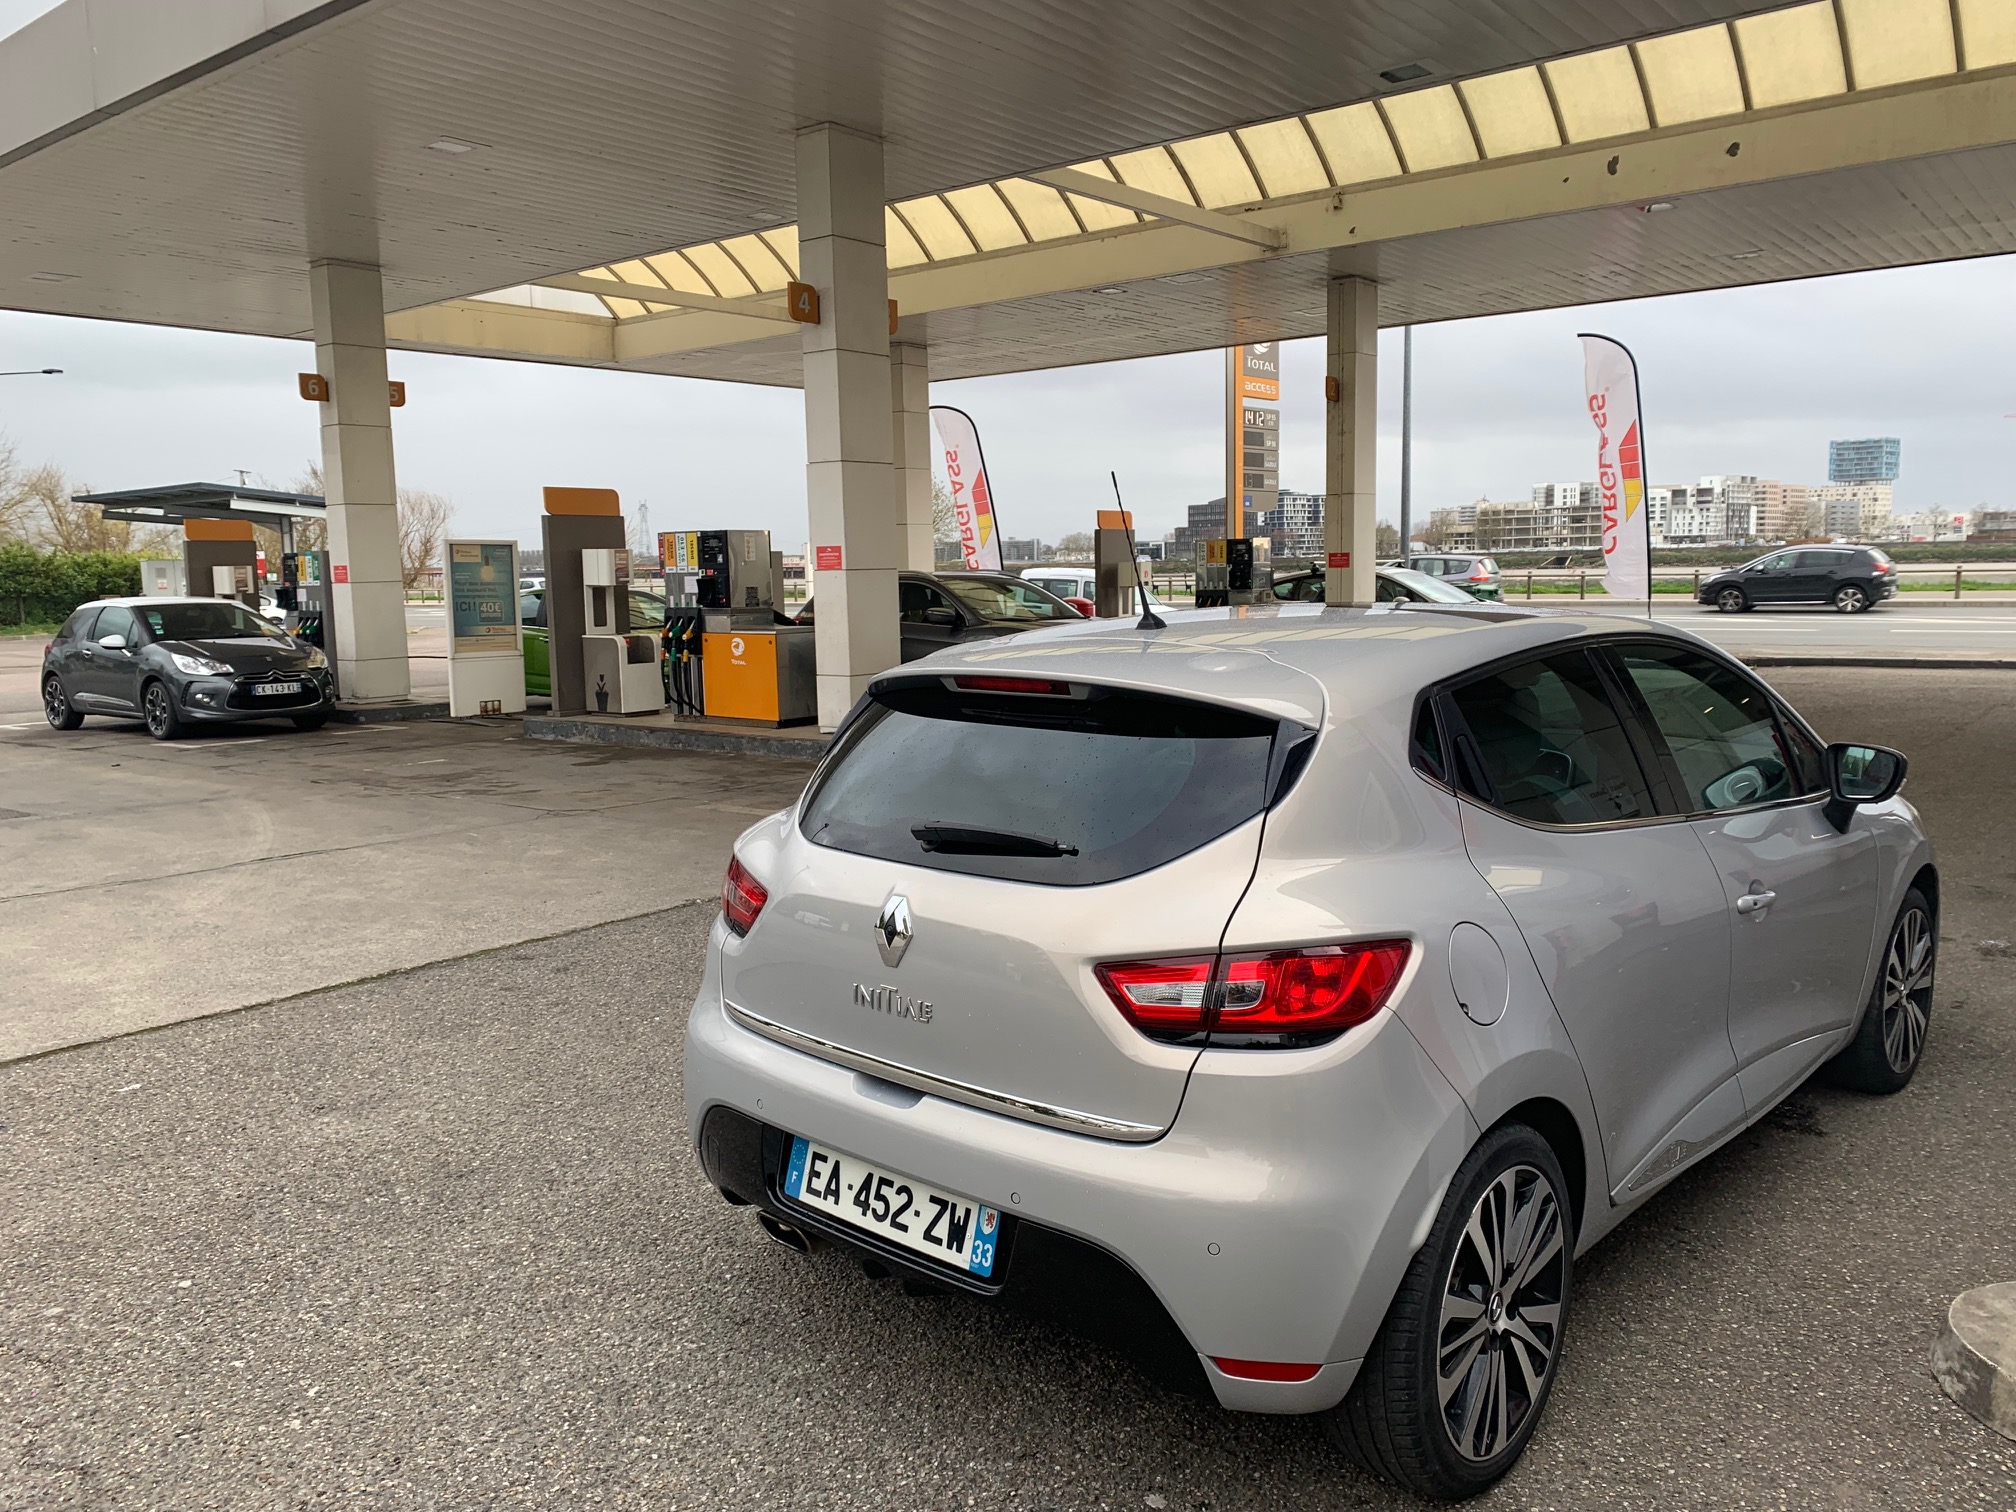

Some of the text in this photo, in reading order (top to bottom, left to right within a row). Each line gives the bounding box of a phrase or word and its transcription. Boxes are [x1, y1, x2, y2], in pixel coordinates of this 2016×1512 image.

[799, 292, 811, 314] 4
[1246, 355, 1277, 372] TOTAL
[308, 379, 319, 395] 6
[389, 386, 399, 401] 5
[731, 658, 747, 666] TOTAL
[790, 1171, 799, 1183] F
[972, 1240, 993, 1268] 33
